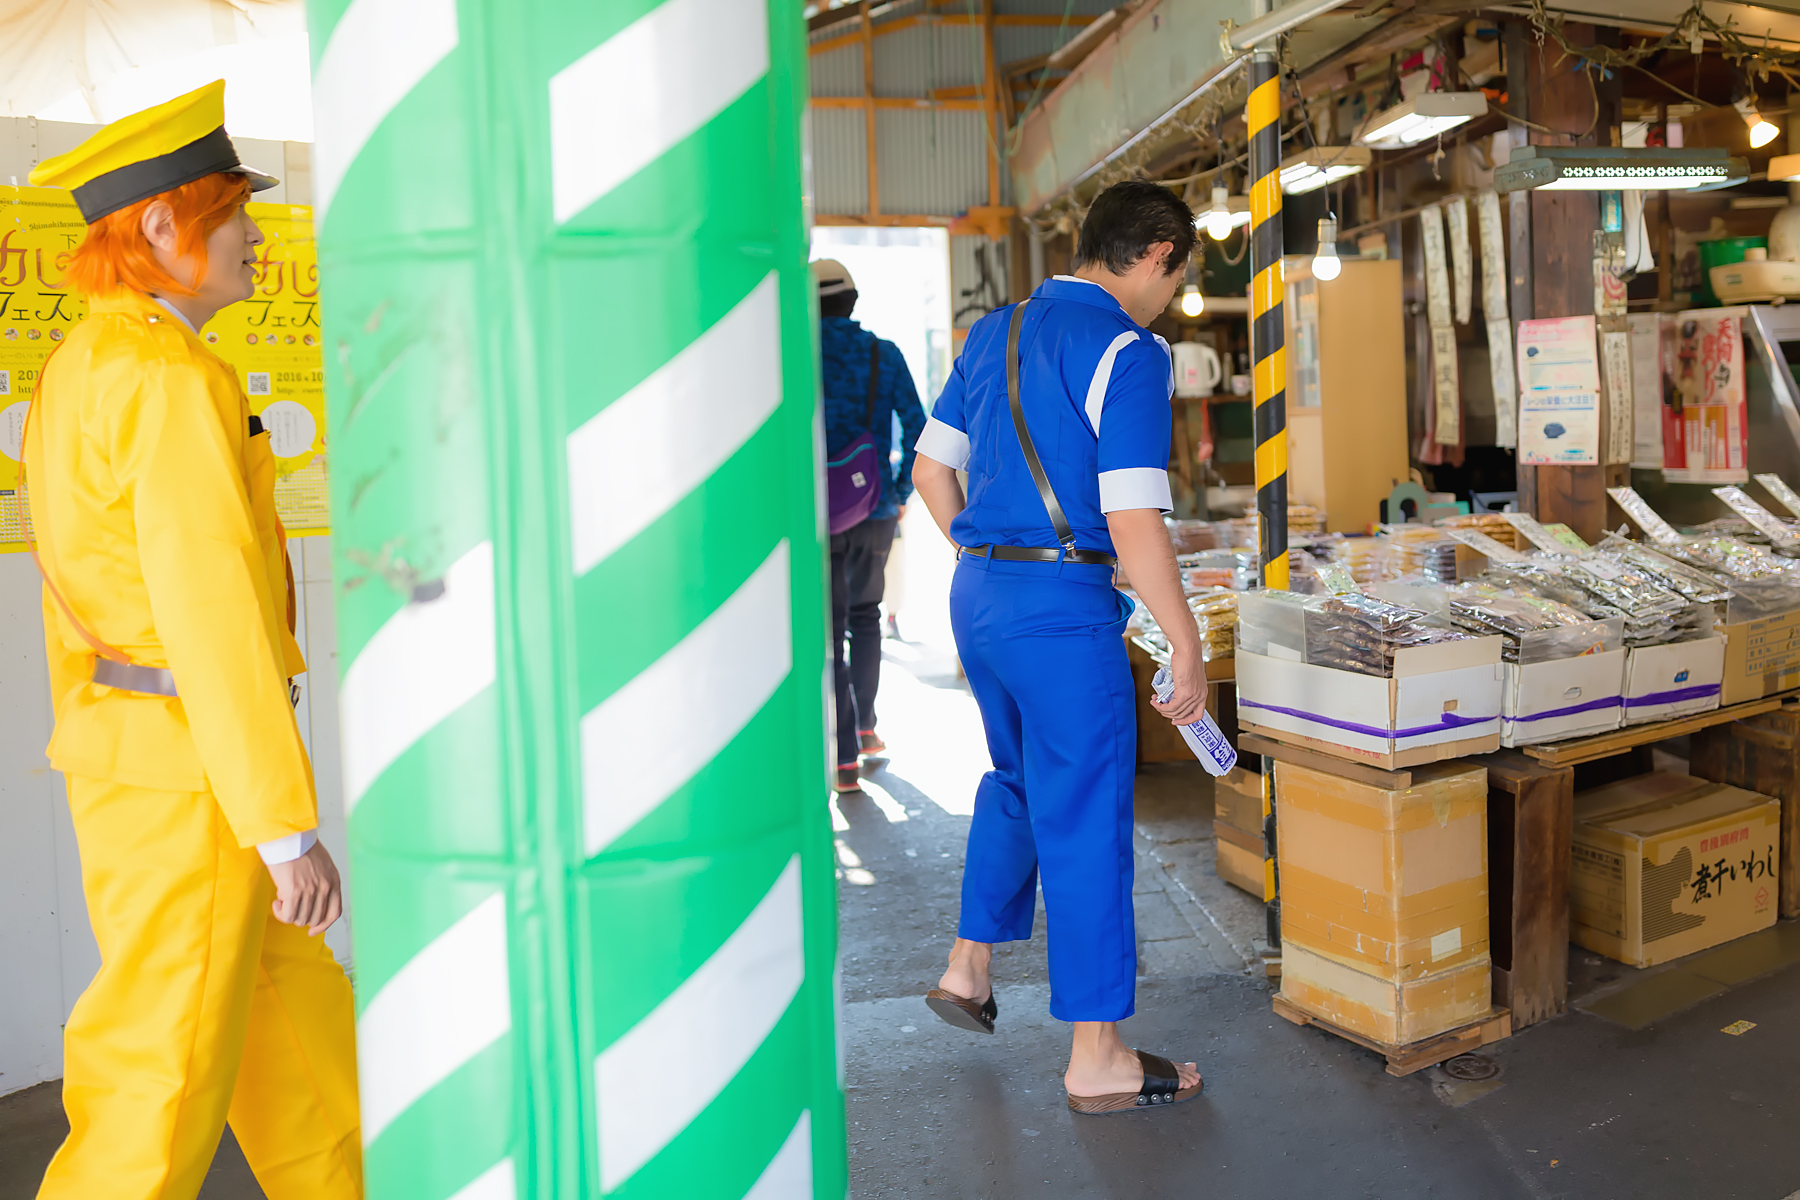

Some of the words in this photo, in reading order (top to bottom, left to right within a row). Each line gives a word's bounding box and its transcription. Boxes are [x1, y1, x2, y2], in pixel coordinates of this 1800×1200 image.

[1691, 844, 1777, 904] 煮干いわし
